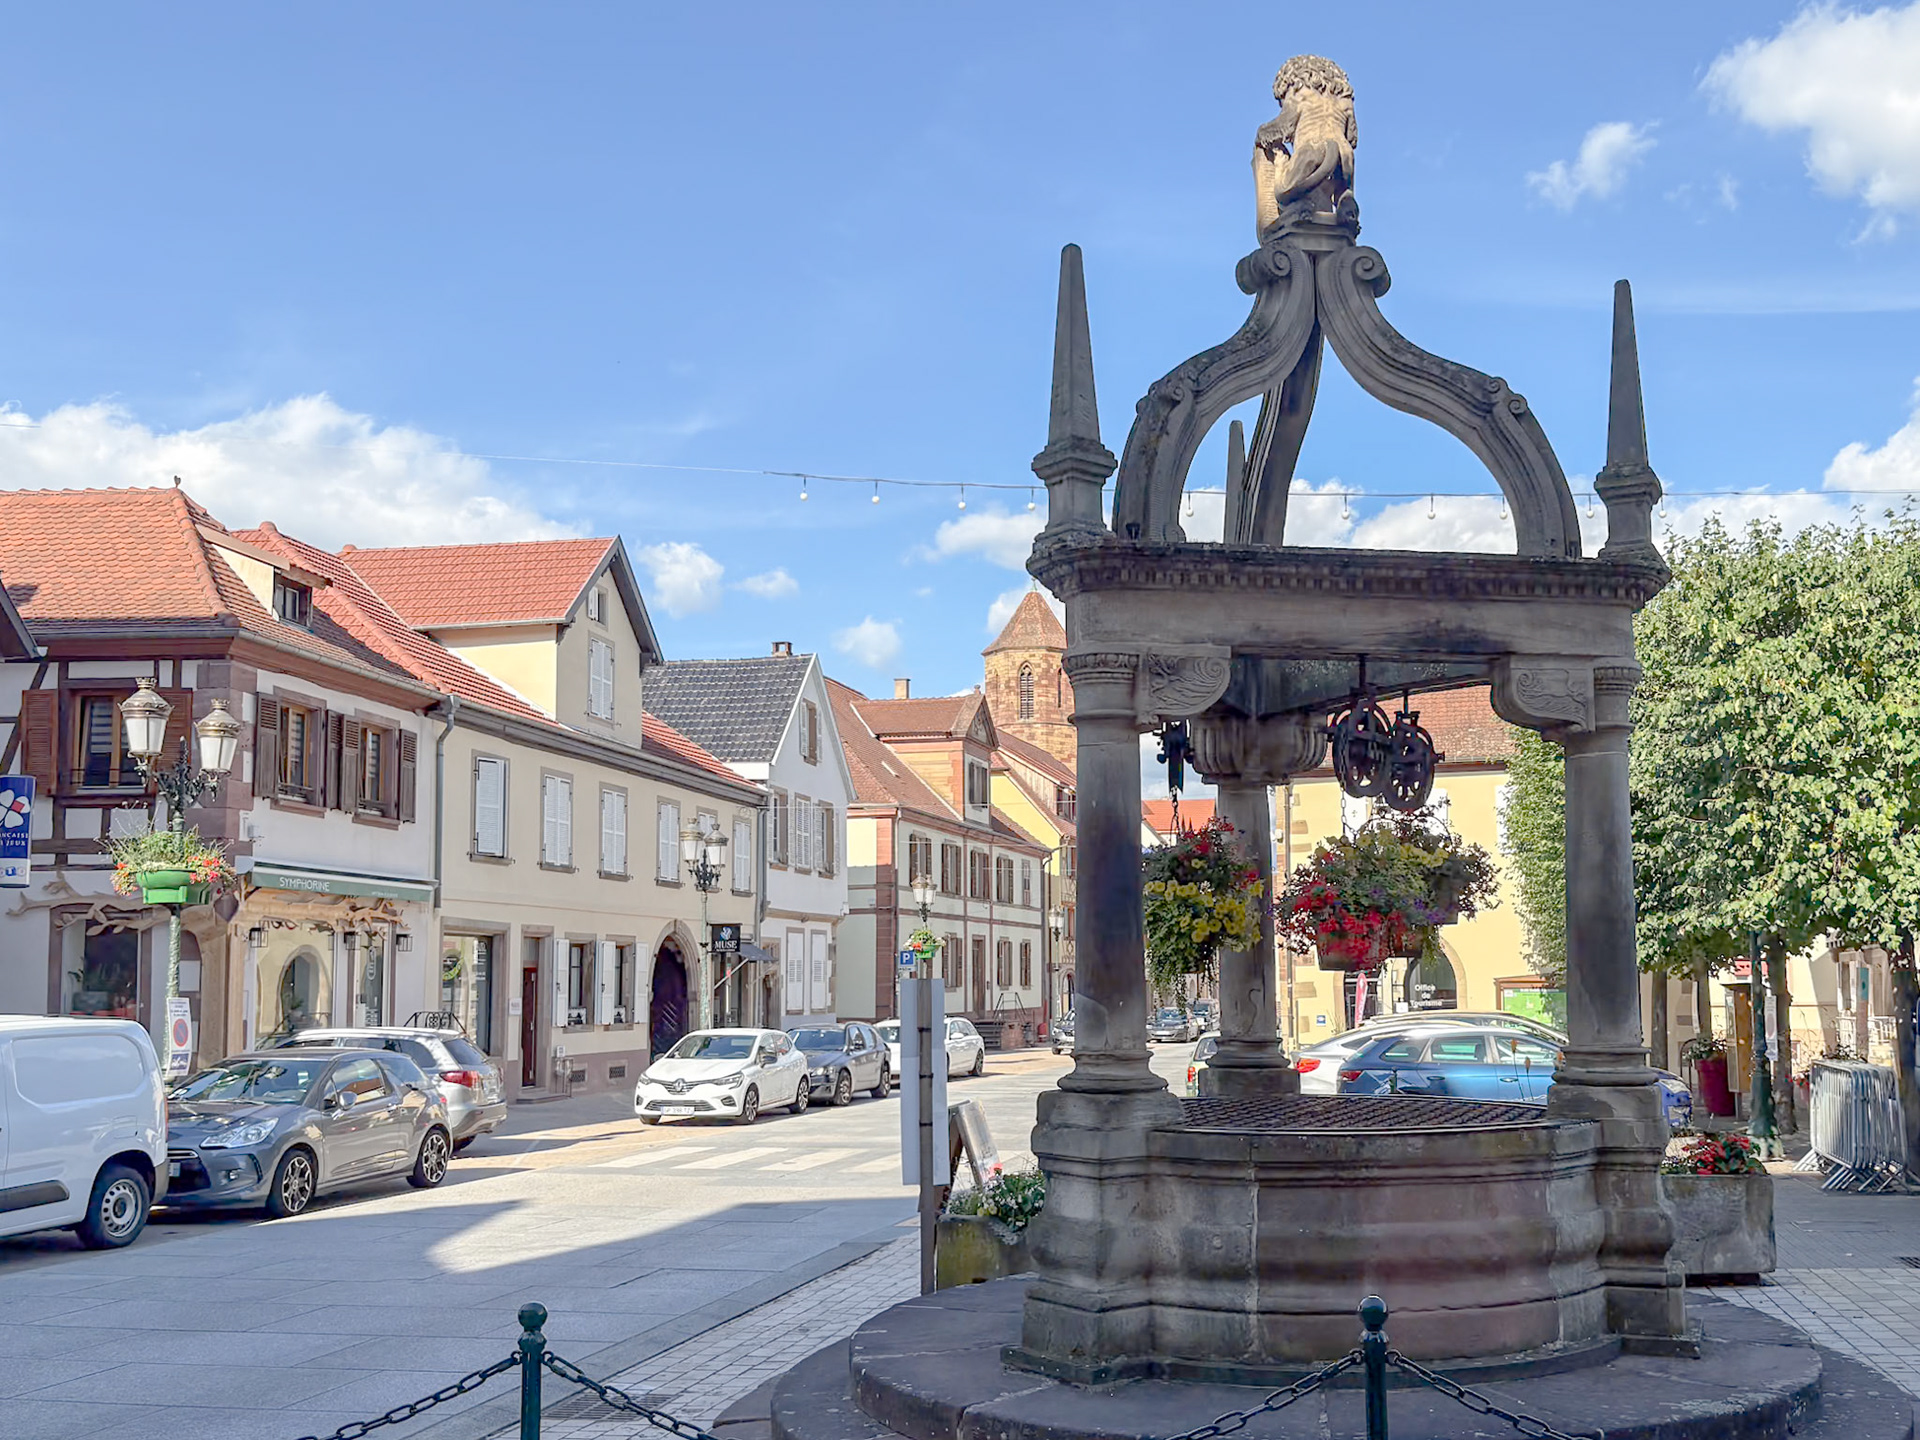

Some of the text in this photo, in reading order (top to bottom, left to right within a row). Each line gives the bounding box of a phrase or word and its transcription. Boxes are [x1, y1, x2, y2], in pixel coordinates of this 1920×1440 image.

[279, 876, 331, 892] SYMPHORINE
[715, 940, 738, 949] MUSE
[902, 952, 910, 964] P
[1414, 983, 1436, 993] Office
[1421, 991, 1431, 1000] de
[1410, 1000, 1442, 1008] Tourisme
